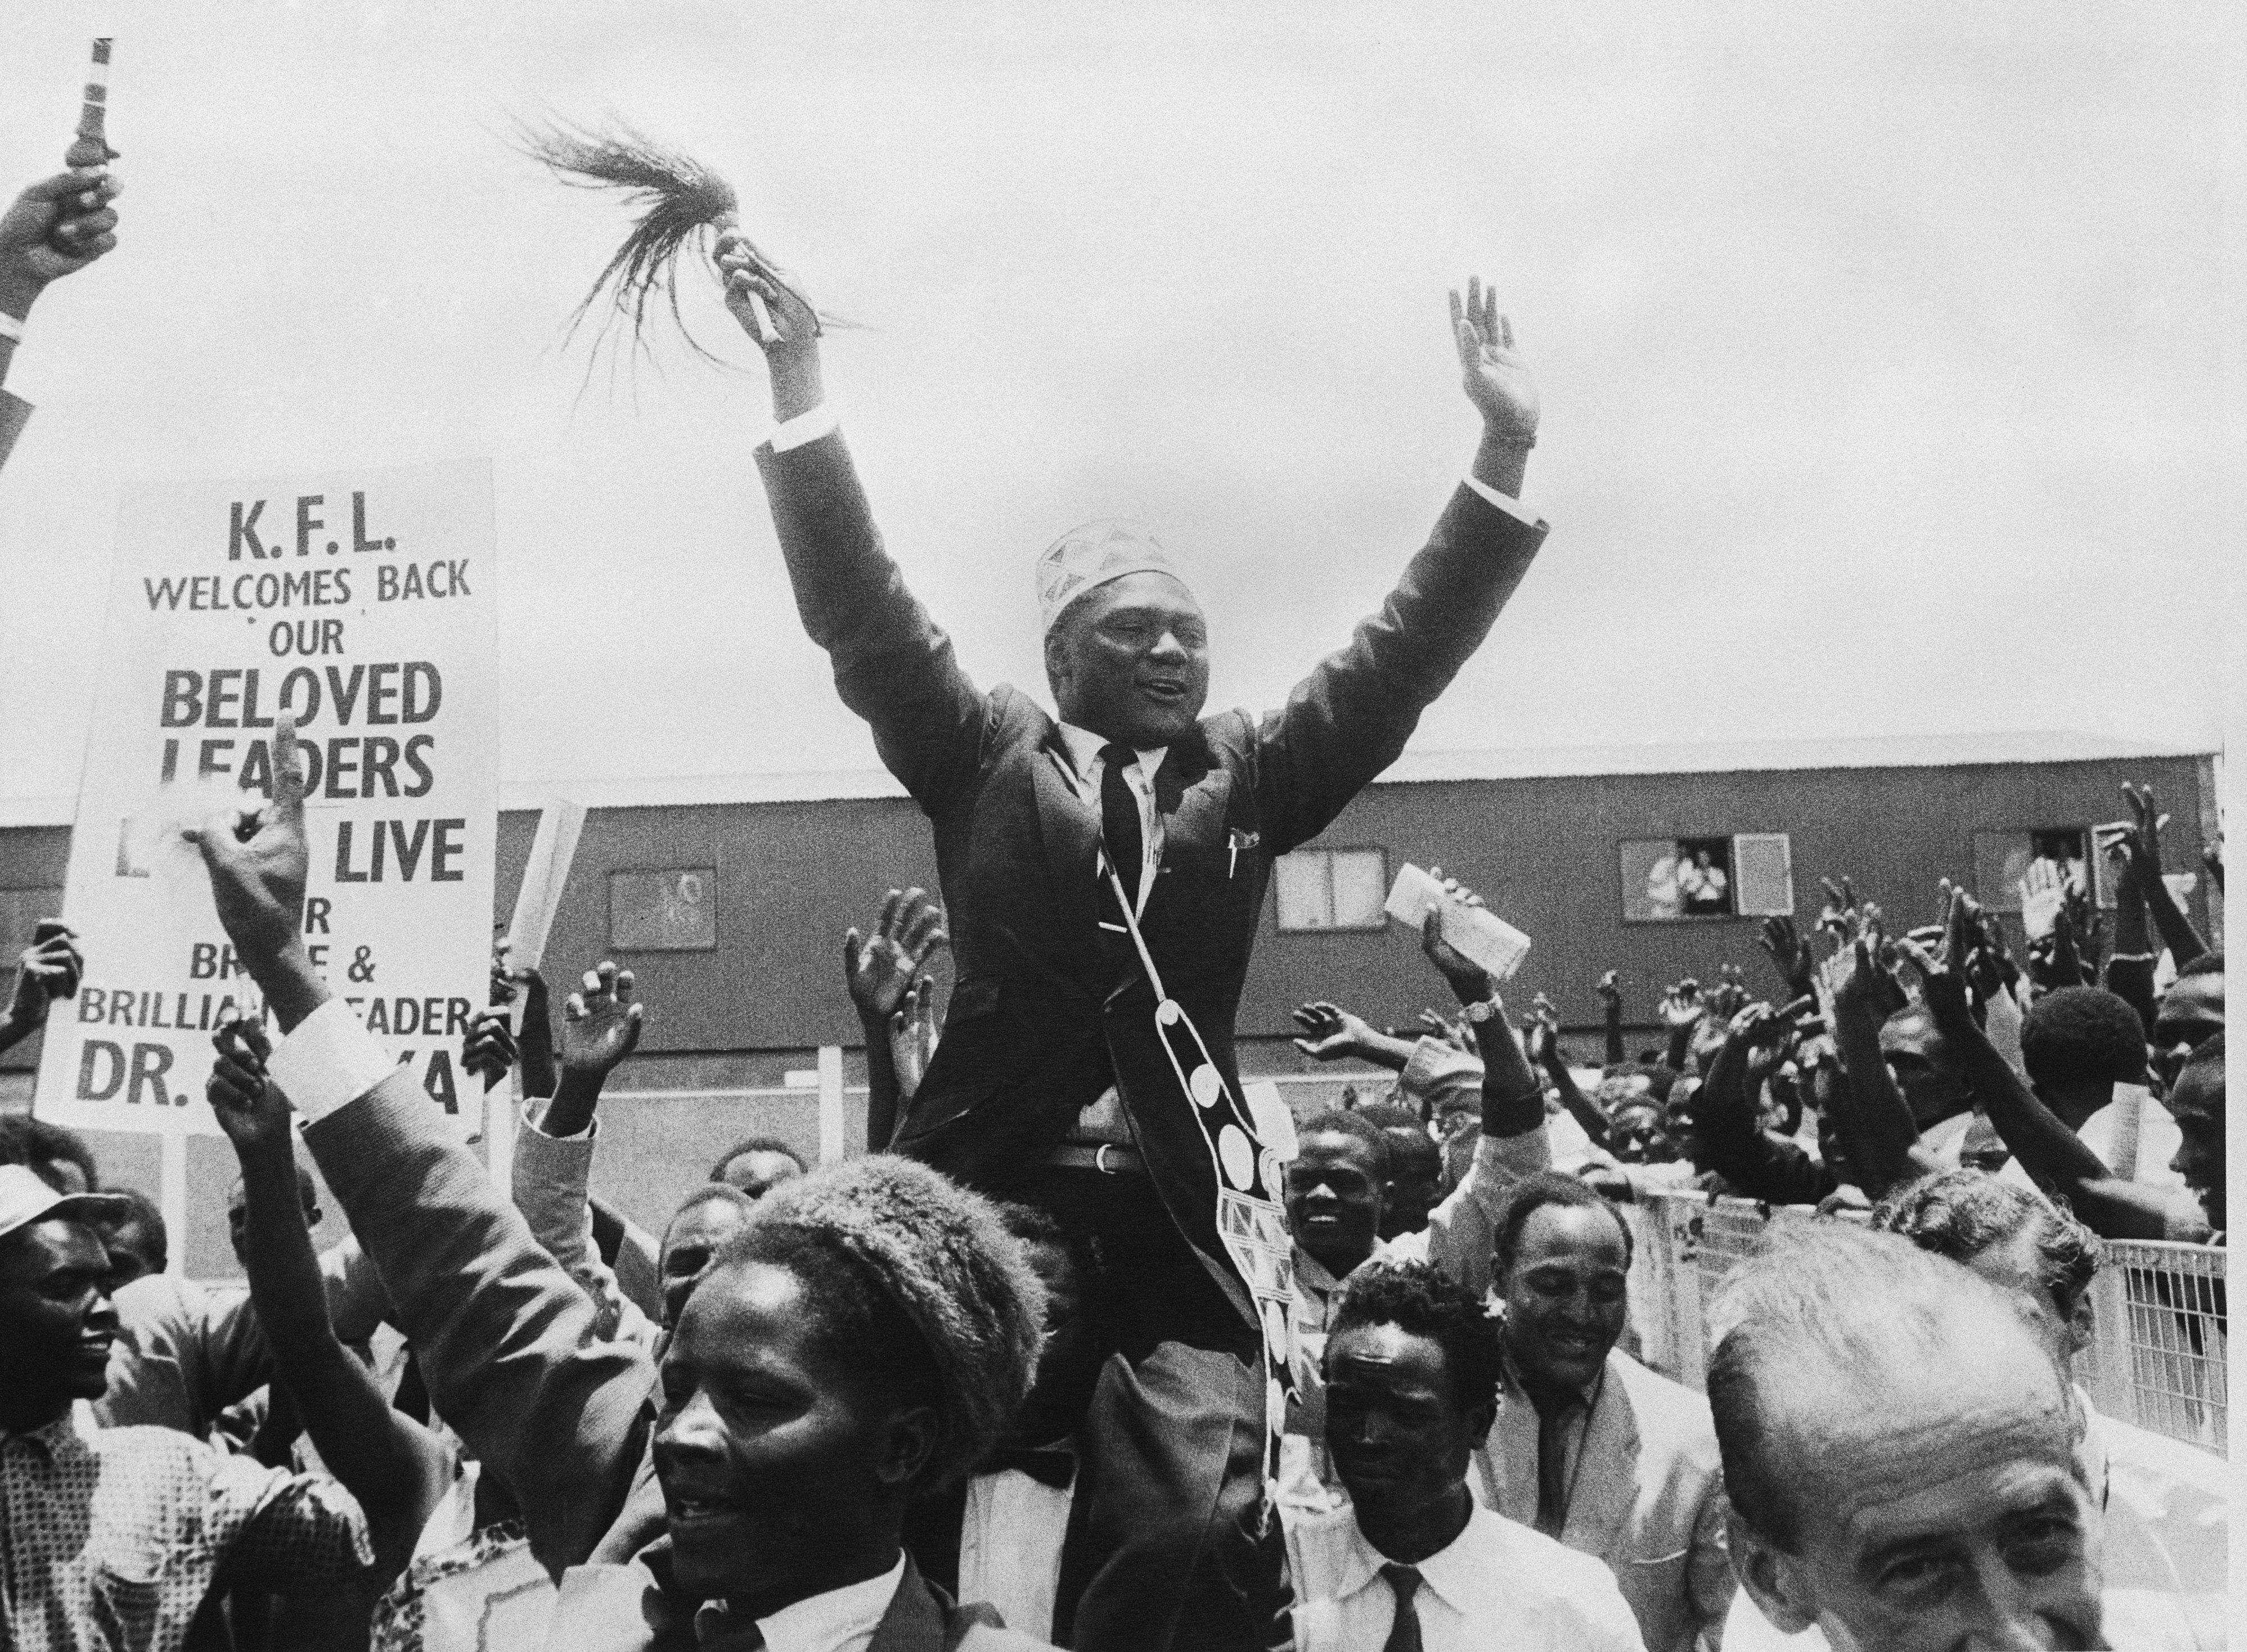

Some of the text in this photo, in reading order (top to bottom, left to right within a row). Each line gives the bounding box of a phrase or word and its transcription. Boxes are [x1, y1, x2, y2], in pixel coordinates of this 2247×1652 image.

[144, 559, 470, 610] WELCOMES BACK
[269, 619, 344, 657] OUR
[160, 661, 442, 728] BELOVED
[334, 818, 466, 882] LIVE
[347, 945, 376, 983] &
[76, 1039, 188, 1107] DR.
